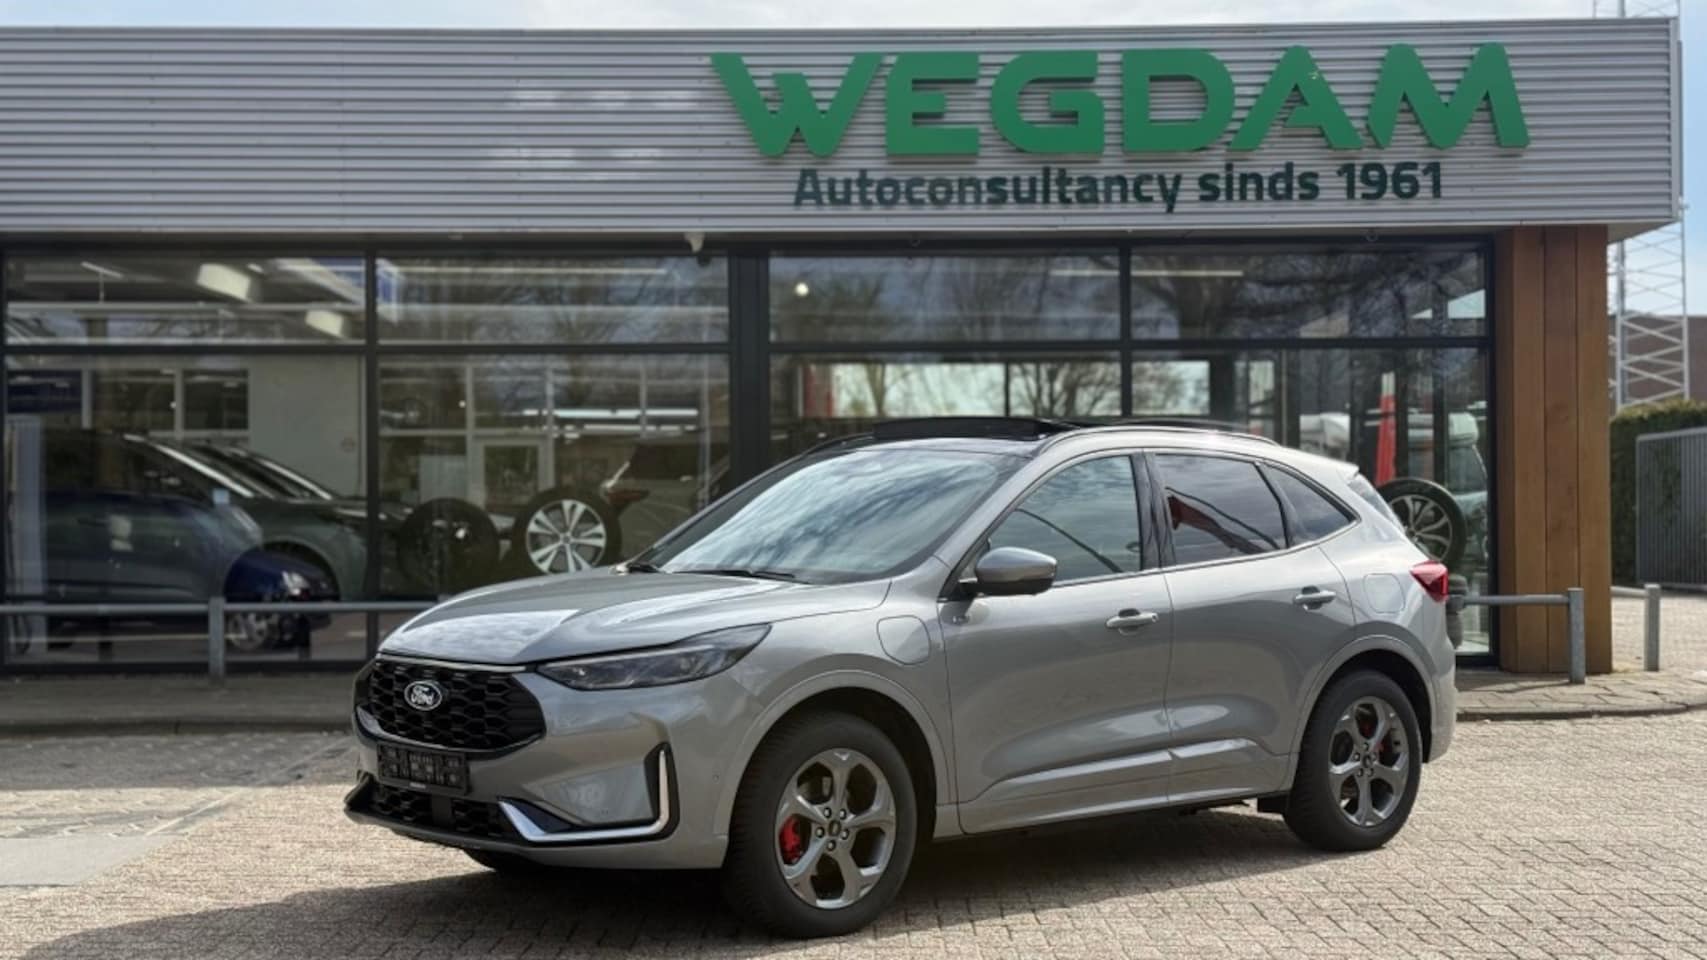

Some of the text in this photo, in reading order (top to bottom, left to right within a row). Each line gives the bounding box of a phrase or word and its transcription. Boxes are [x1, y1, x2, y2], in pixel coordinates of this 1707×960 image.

[711, 44, 1530, 156] WEGDAM
[794, 161, 1442, 213] Autoconsultancy sinds 1961
